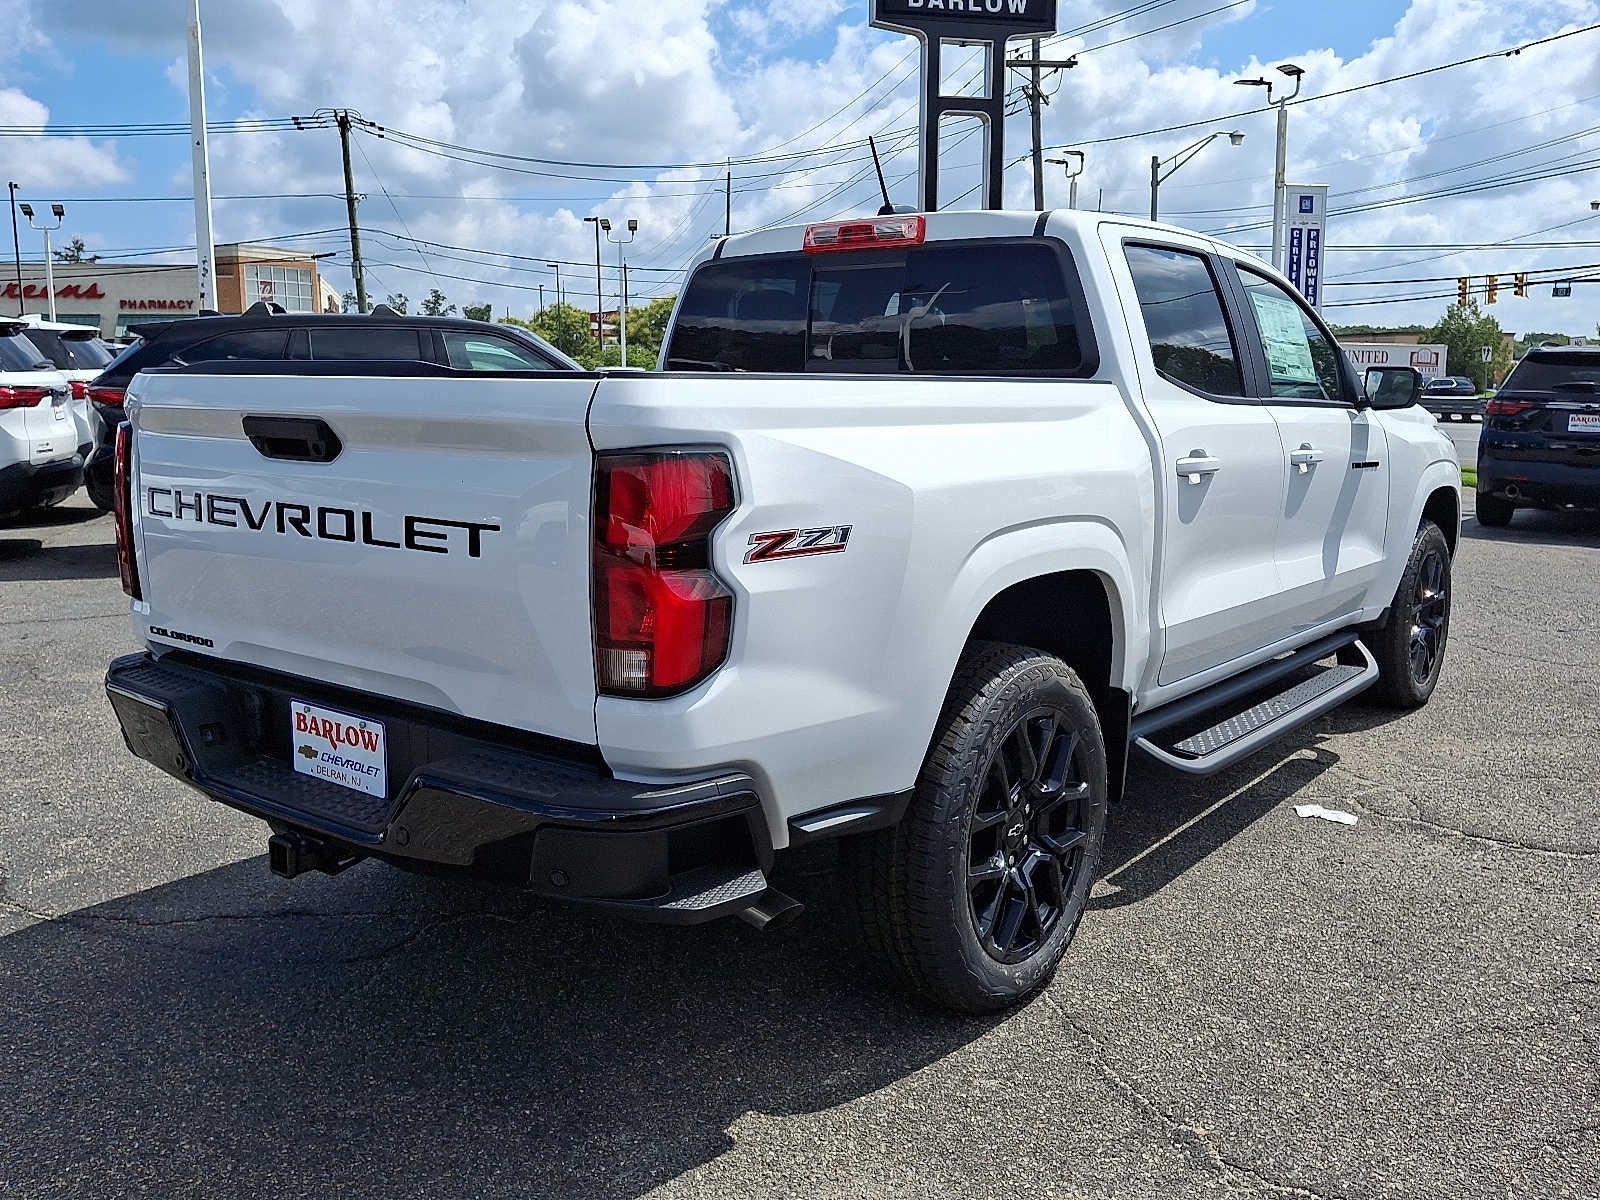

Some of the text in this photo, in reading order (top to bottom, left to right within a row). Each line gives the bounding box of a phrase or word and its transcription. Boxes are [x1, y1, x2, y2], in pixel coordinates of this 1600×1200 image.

[1306, 231, 1317, 304] PREOWNED
[119, 299, 194, 310] PHARMACY
[1570, 416, 1600, 424] BARLO
[147, 487, 501, 558] CHEVROLET
[742, 524, 853, 565] Z71
[149, 625, 214, 648] COLORADO
[295, 711, 380, 753] BARLOW
[320, 752, 381, 778] CHEVROLET
[351, 775, 362, 787] NJ
